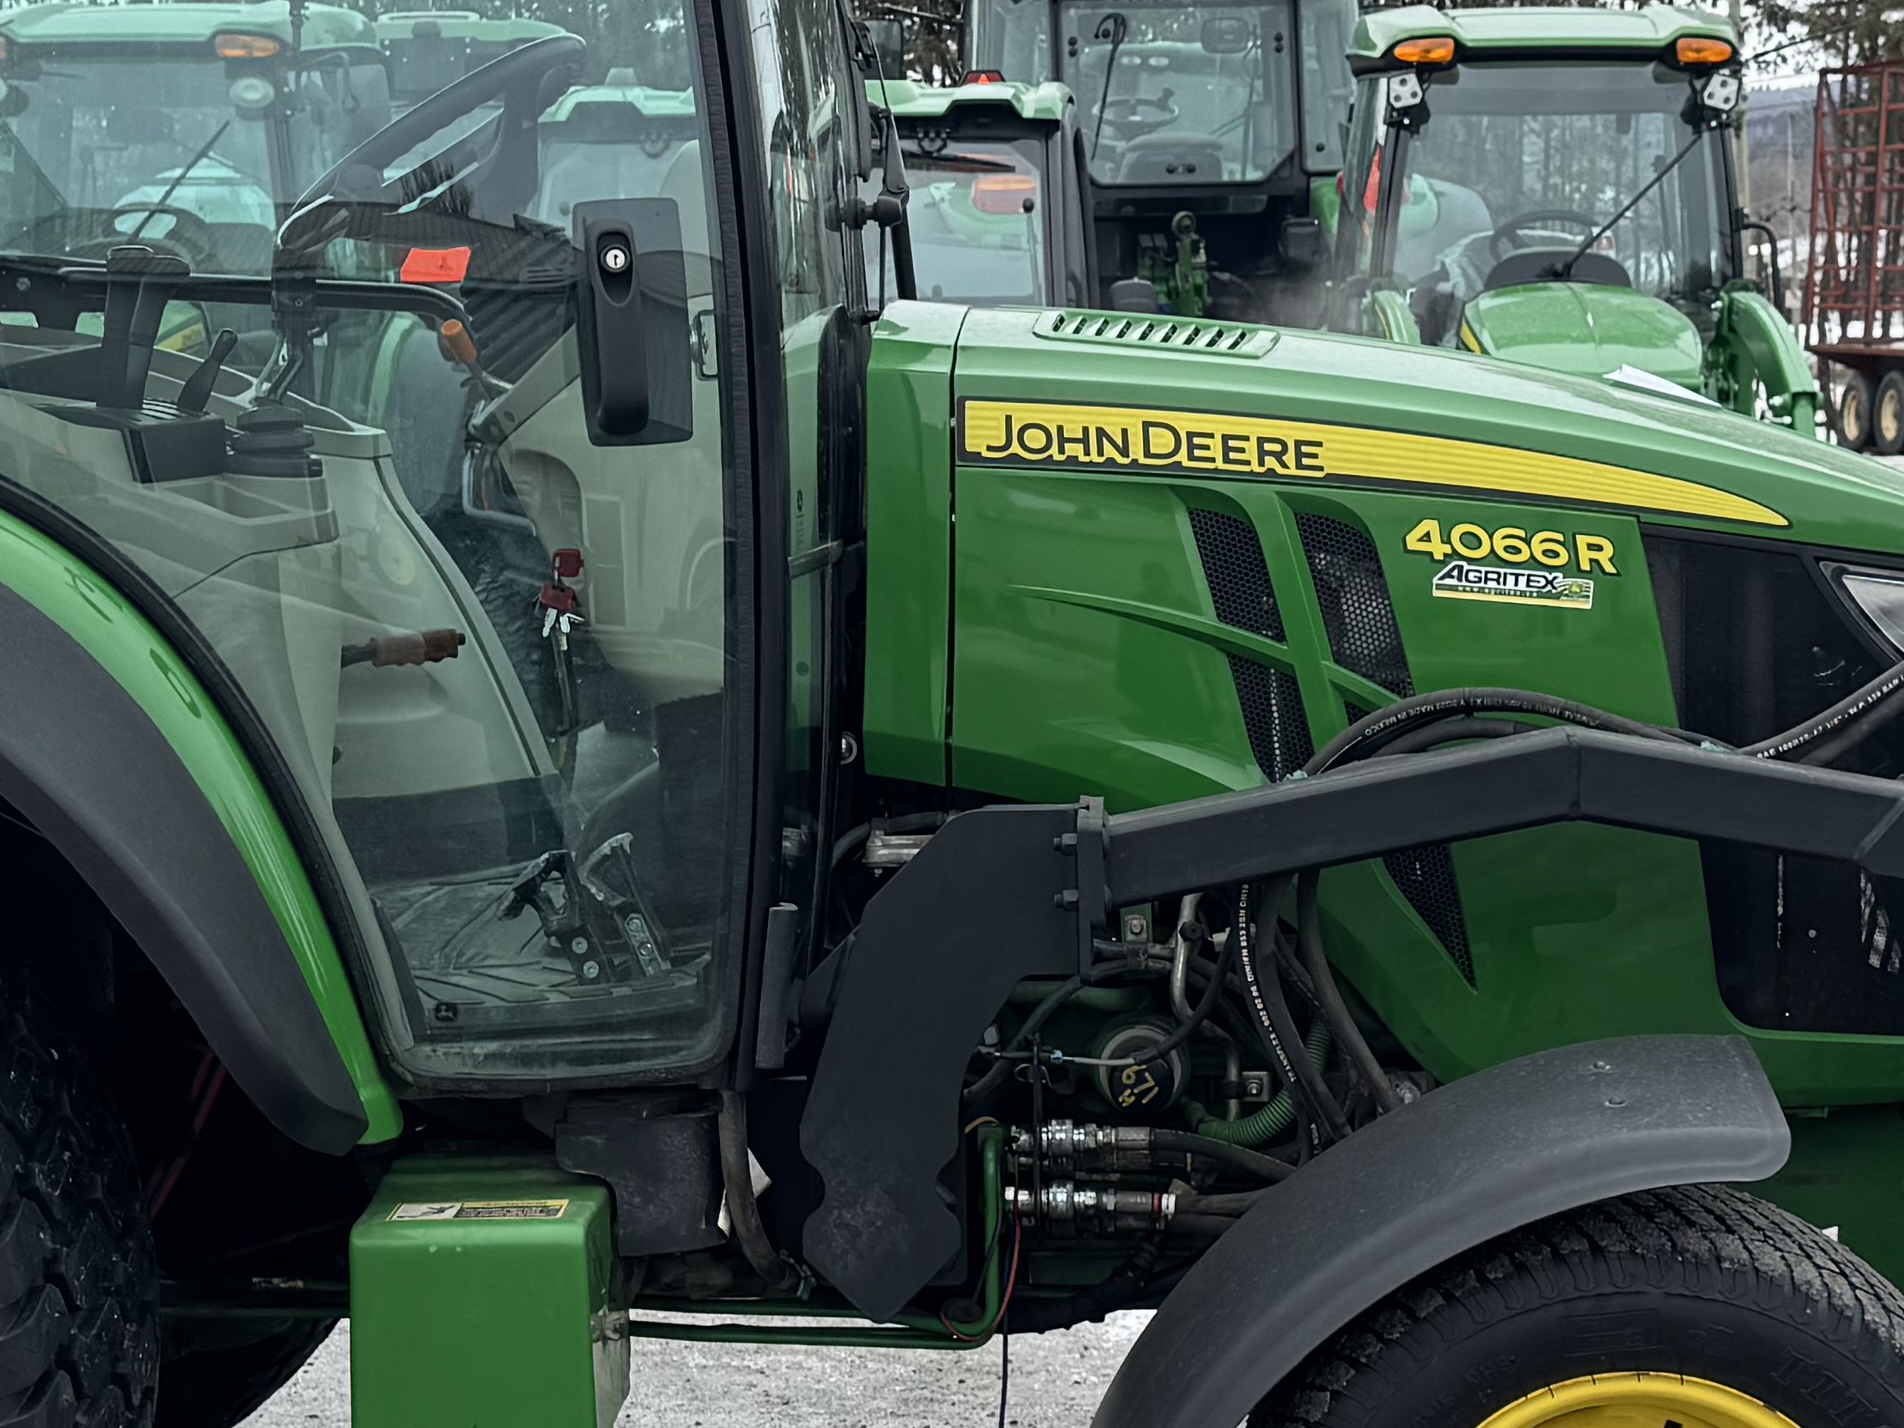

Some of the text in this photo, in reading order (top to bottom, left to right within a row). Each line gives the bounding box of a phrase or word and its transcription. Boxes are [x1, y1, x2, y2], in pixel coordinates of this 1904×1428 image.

[985, 414, 1325, 472] JOHN DEERE
[1436, 563, 1560, 593] AGRITEX
